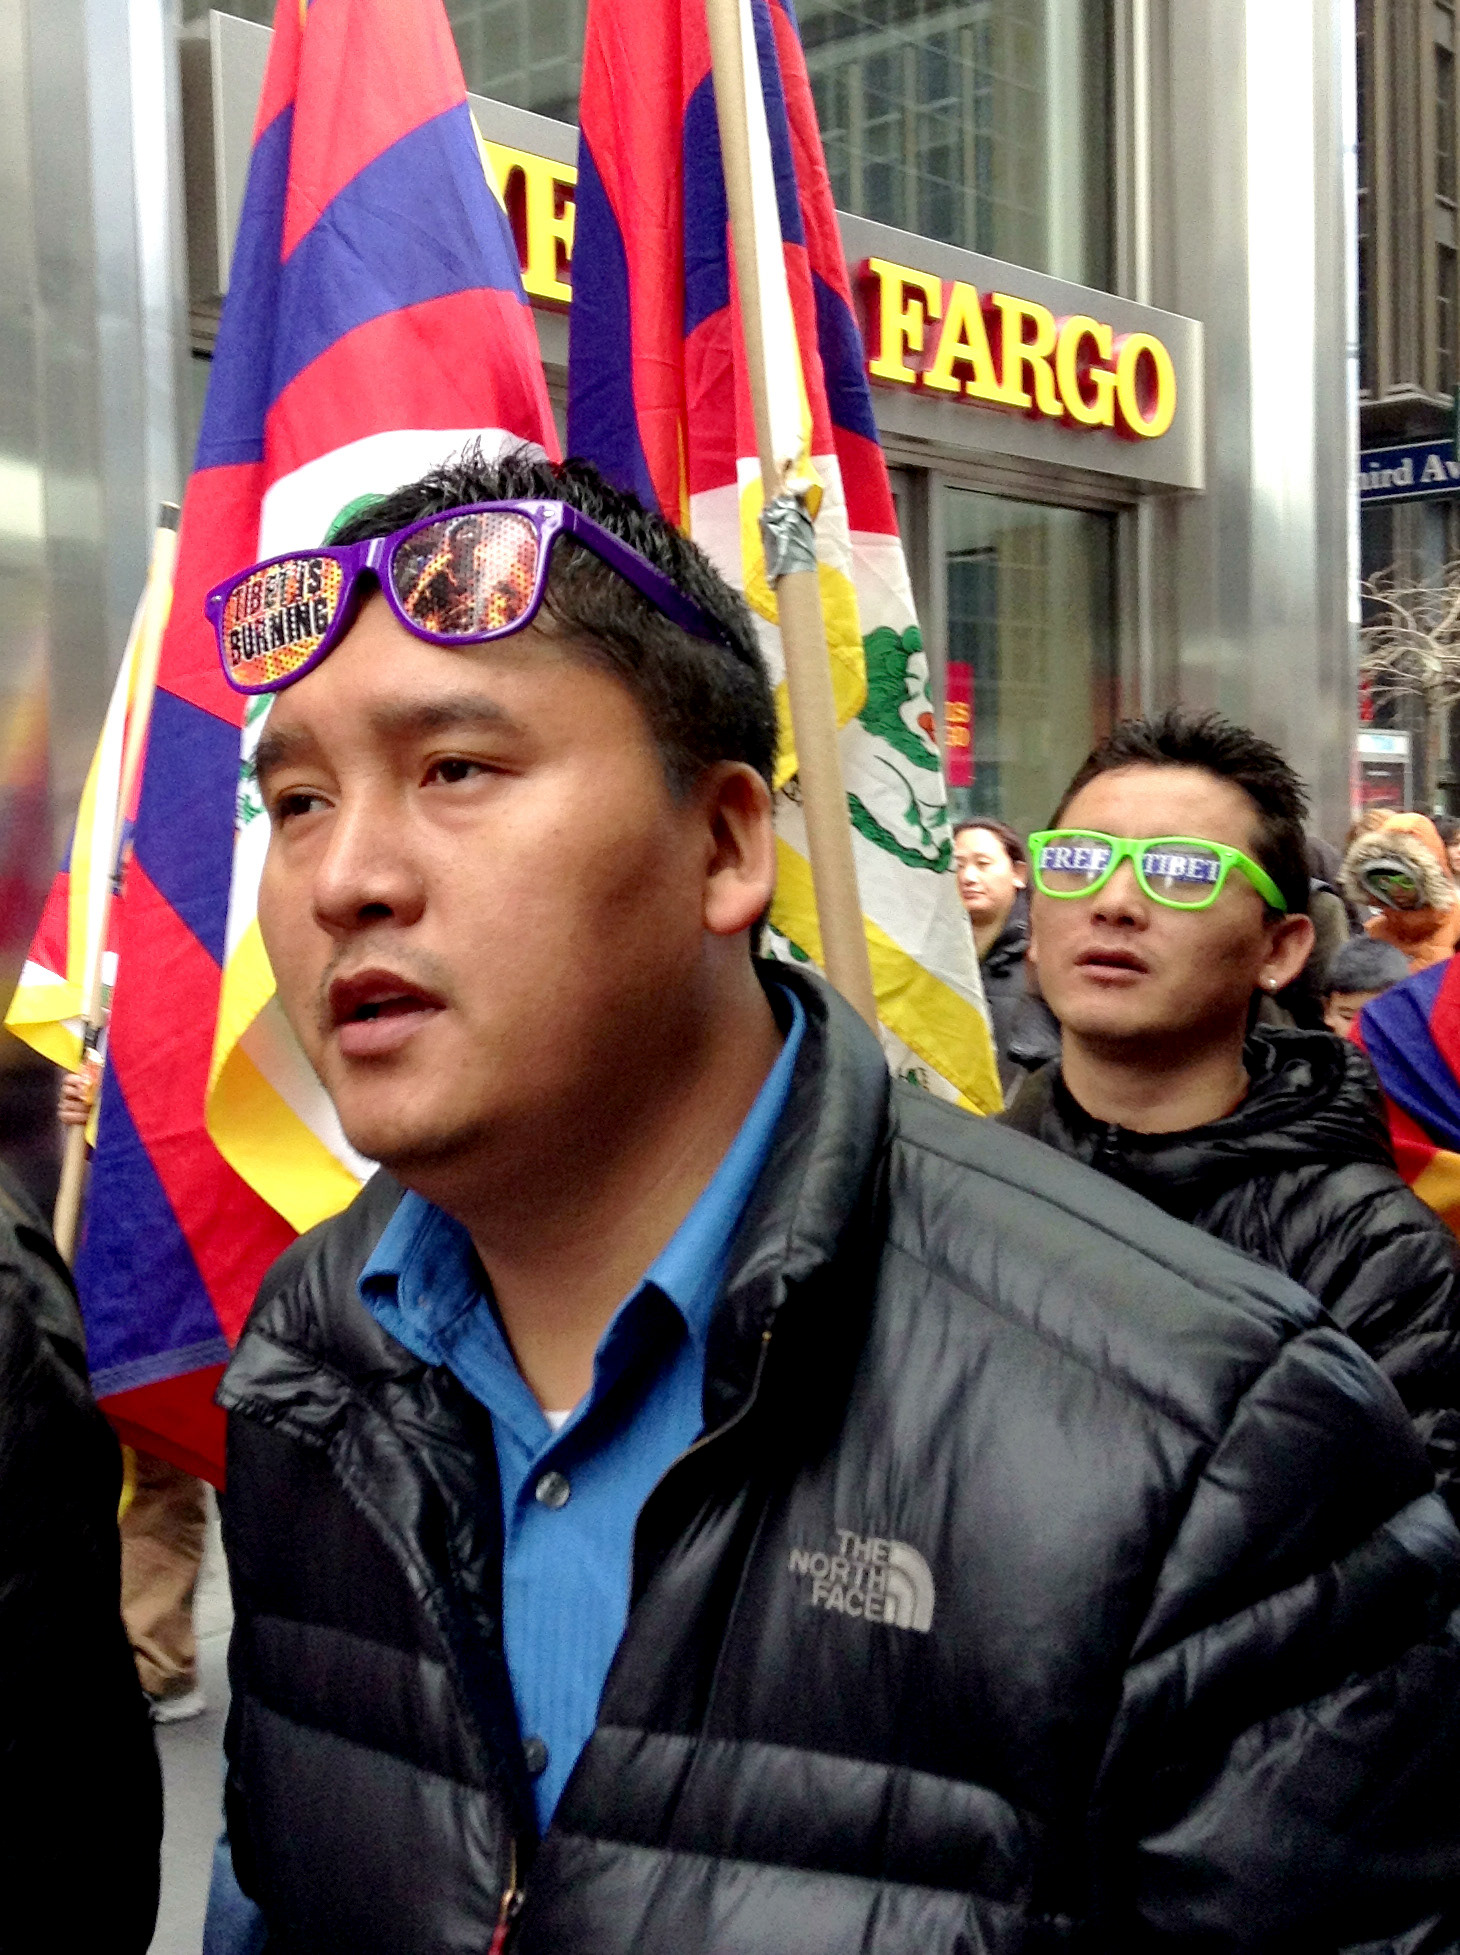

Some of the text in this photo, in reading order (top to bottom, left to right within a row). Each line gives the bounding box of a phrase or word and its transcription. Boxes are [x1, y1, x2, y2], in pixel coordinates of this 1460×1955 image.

[869, 256, 1177, 438] FARGO
[232, 559, 322, 622] TIBET IS
[229, 596, 329, 667] BURNING
[1040, 846, 1220, 882] FREE TIBET
[836, 1528, 889, 1563] THE
[788, 1549, 887, 1594] NORTH
[812, 1579, 885, 1622] FACE
